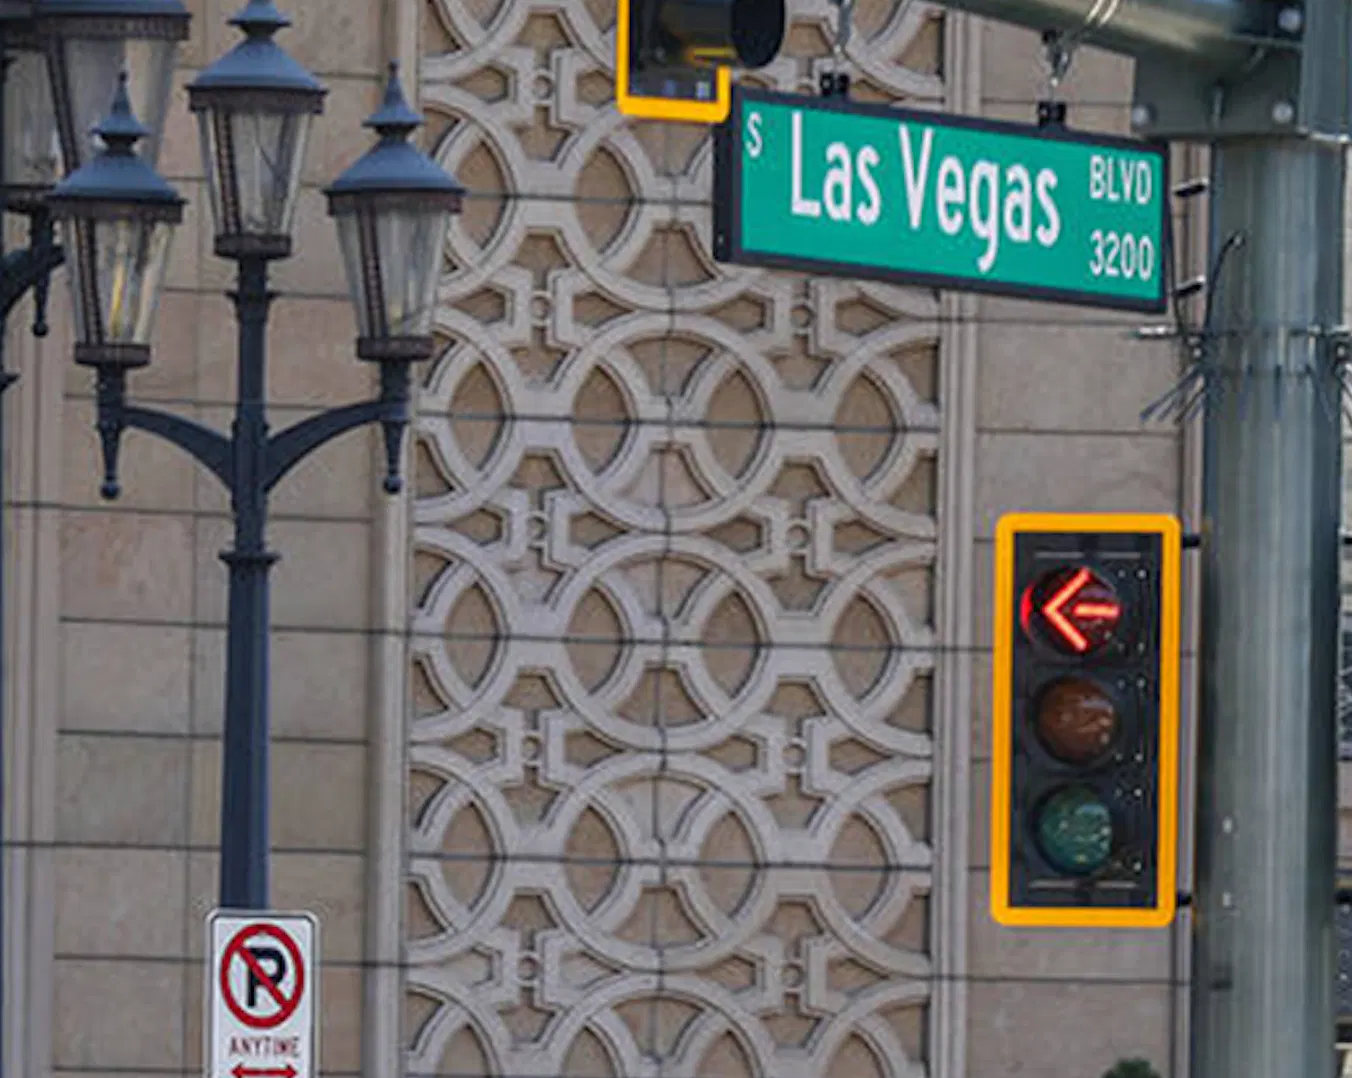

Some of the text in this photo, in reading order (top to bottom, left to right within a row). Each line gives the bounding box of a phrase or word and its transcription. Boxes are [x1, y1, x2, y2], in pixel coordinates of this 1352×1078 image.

[745, 111, 1153, 274] S Las Vegas BLVD
[1089, 231, 1154, 281] 3200
